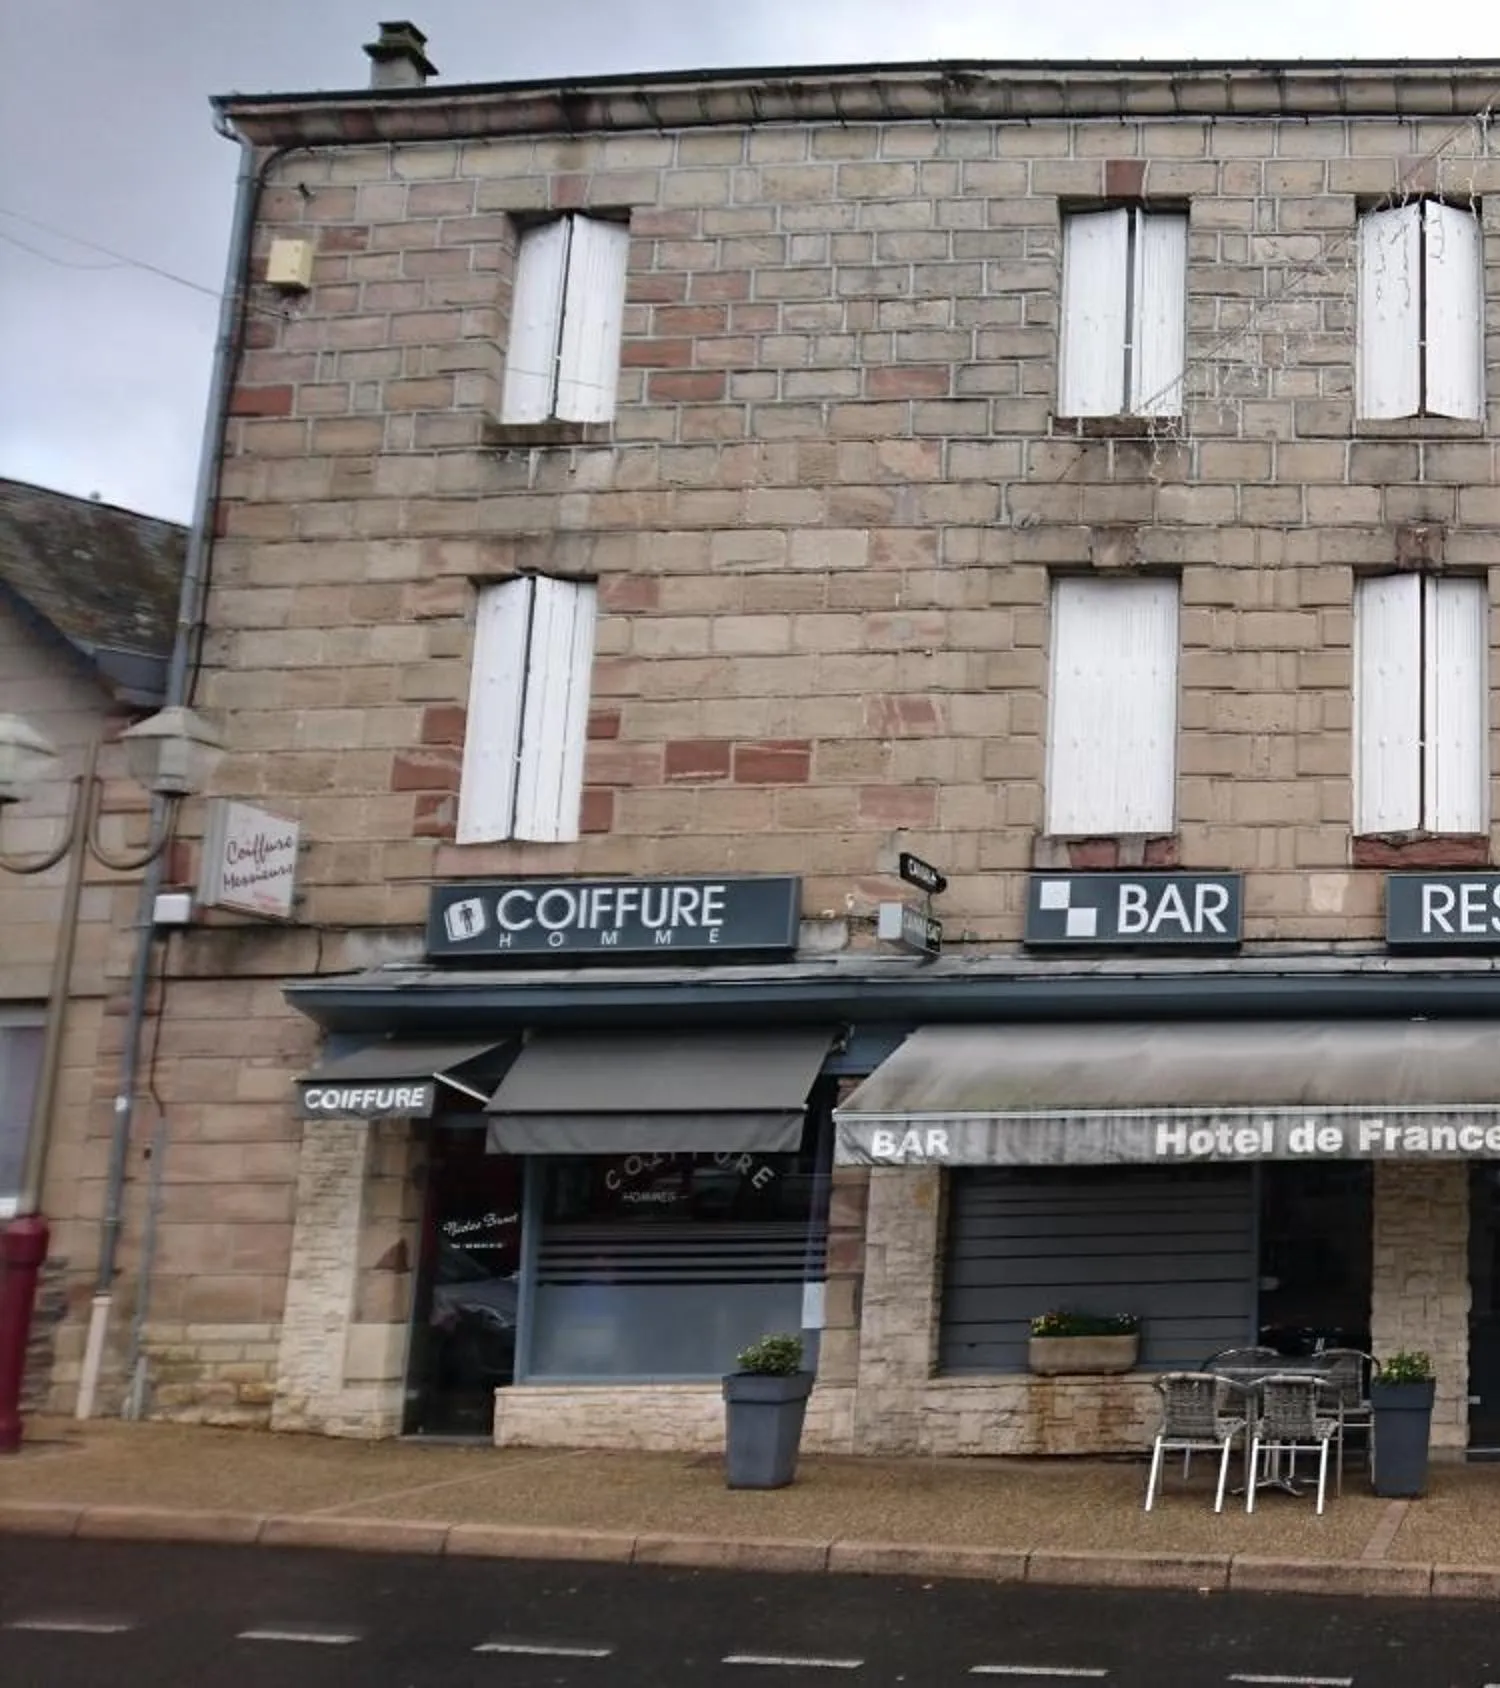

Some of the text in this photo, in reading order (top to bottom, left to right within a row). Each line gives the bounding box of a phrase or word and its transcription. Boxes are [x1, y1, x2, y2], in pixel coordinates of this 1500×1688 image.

[226, 833, 293, 870] Coiffure
[496, 886, 725, 931] COIFFURE
[1117, 883, 1229, 933] BAR
[499, 929, 720, 948] HOMME
[304, 1086, 425, 1109] COIFFURE
[871, 1128, 949, 1157] BAR
[1155, 1120, 1274, 1154] Hotel
[1289, 1119, 1343, 1152] de
